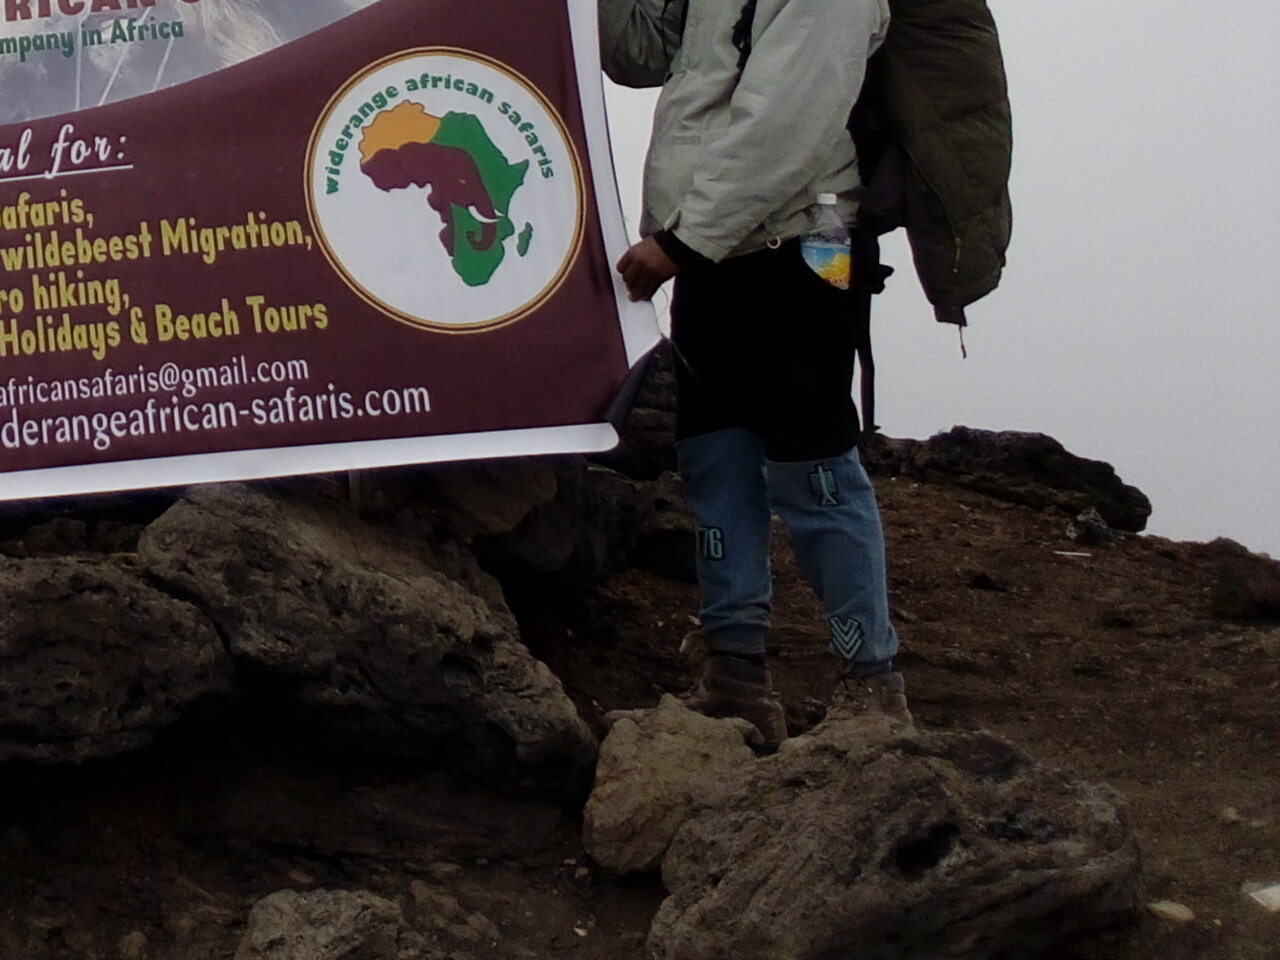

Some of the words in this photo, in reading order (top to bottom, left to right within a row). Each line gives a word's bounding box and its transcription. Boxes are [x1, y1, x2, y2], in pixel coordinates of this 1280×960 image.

[81, 23, 102, 46] in
[110, 16, 184, 44] Africa
[45, 124, 126, 179] for:
[326, 84, 399, 195] widerange
[405, 73, 494, 104] african
[498, 100, 554, 179] safaris
[0, 221, 152, 271] wildebeest
[160, 211, 312, 264] Migration,
[32, 270, 129, 315] hiking,
[130, 306, 148, 344] &
[155, 298, 239, 341] Beach
[246, 295, 328, 332] Tours
